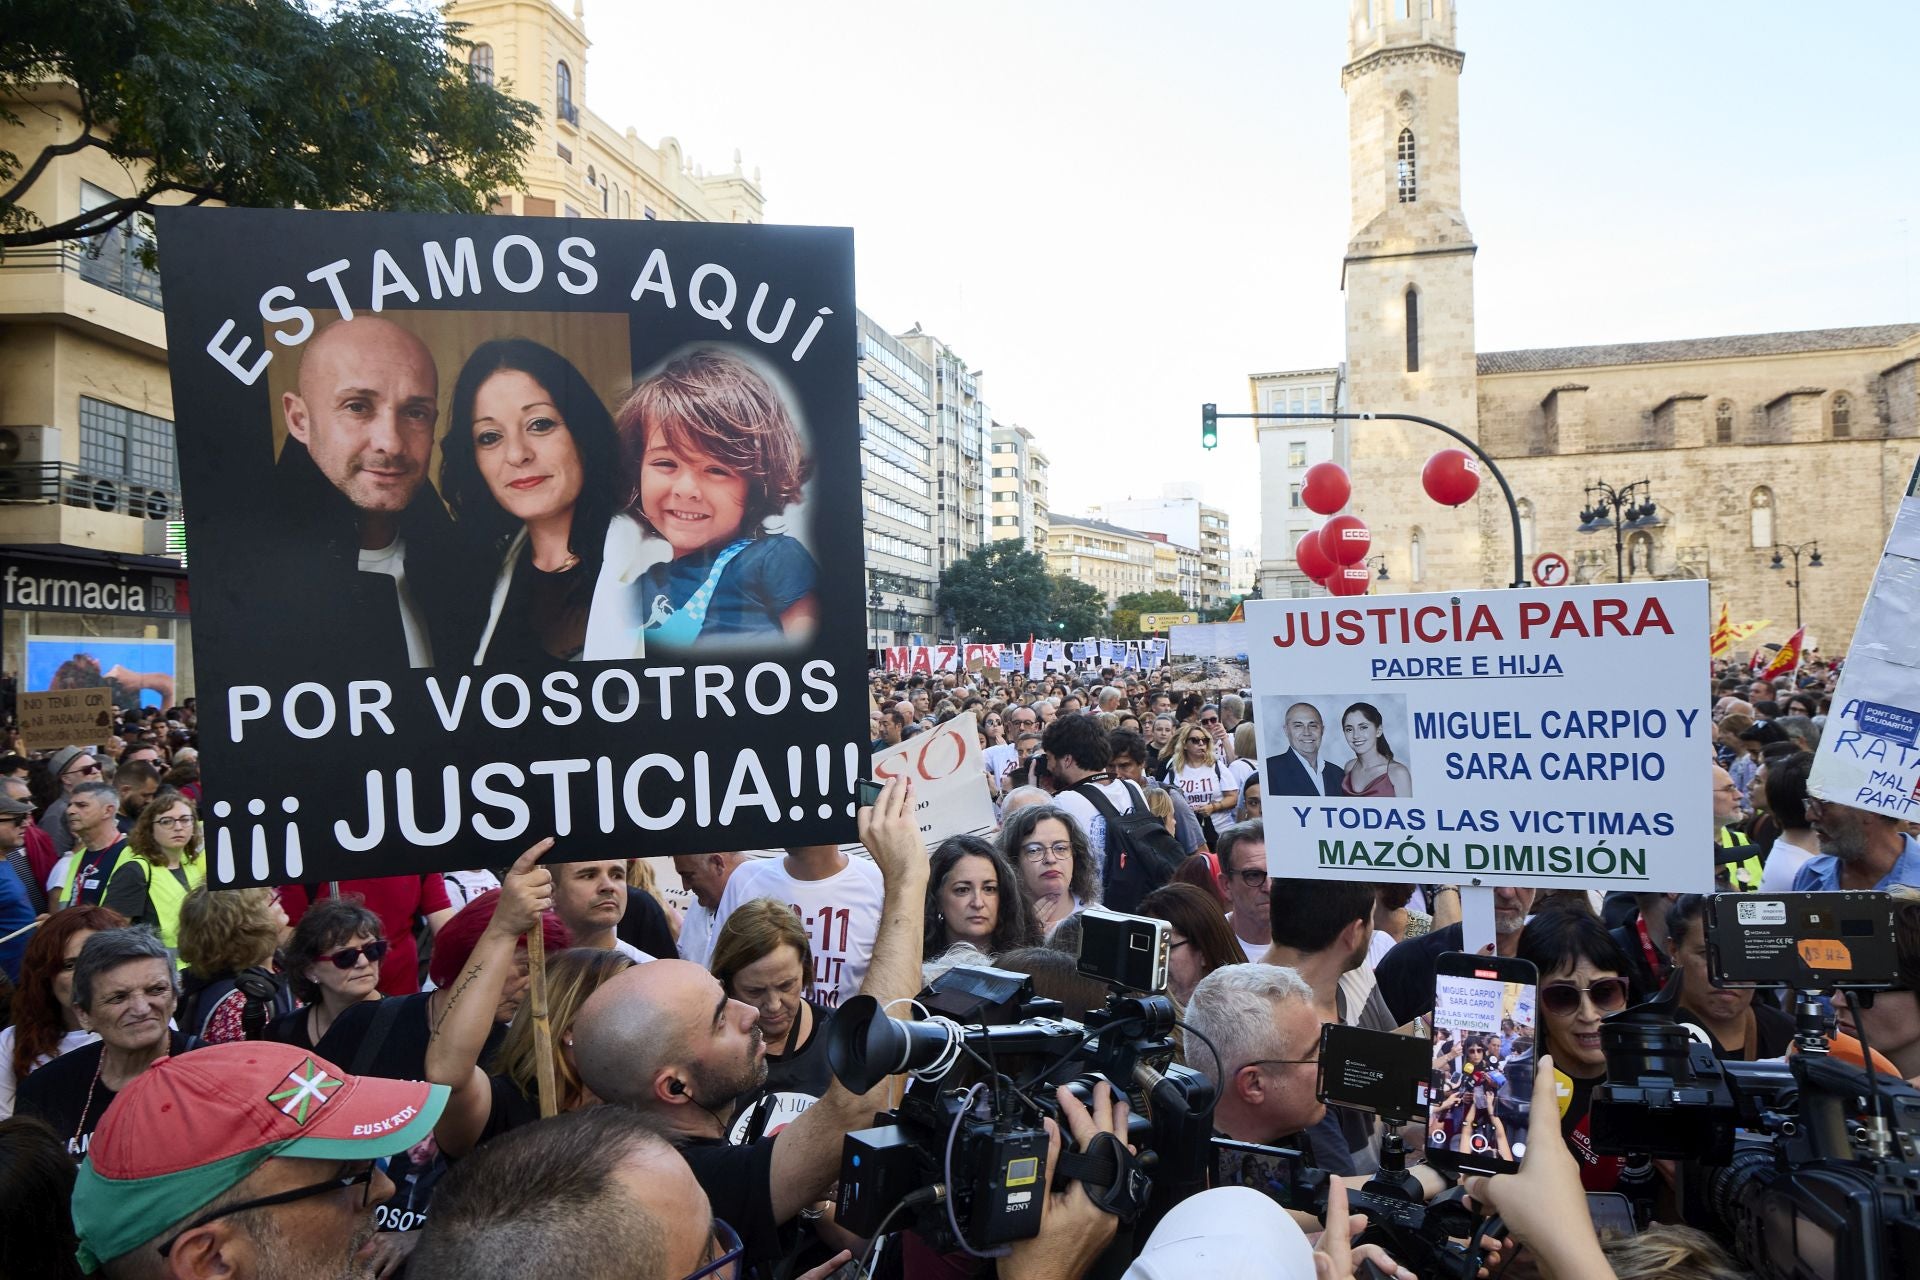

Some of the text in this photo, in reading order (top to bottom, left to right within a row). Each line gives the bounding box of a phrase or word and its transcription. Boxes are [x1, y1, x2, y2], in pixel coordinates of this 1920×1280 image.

[206, 234, 834, 386] ESTAMOS AQUÍ
[4, 566, 146, 612] farmacia
[1518, 596, 1675, 641] PARA
[1371, 654, 1564, 678] PADRE E HIJA
[228, 659, 839, 743] POR VOSOTROS
[1413, 708, 1699, 740] MIGUEL CARPIO Y
[1864, 715, 1914, 733] SOLIDARITAT
[1866, 707, 1913, 724] PONT DE LA
[1445, 751, 1666, 782] SARA CARPIO
[1180, 777, 1213, 793] 20:11
[1868, 770, 1908, 793] MAL
[333, 742, 860, 852] JUSTICIA!!!
[1292, 806, 1675, 836] Y TODAS LAS VICTIMAS
[1318, 835, 1648, 877] MAZÓN DIMISIÓN
[813, 956, 846, 984] LIT
[1442, 986, 1468, 996] MIGUEL
[1470, 989, 1496, 999] CARPIO
[1449, 997, 1495, 1008] SARA CARPIO
[1463, 1012, 1495, 1021] VICTIMAS
[353, 1105, 418, 1136] EUSKADI
[375, 1204, 427, 1232] OSOT
[1005, 1203, 1030, 1213] SONY
